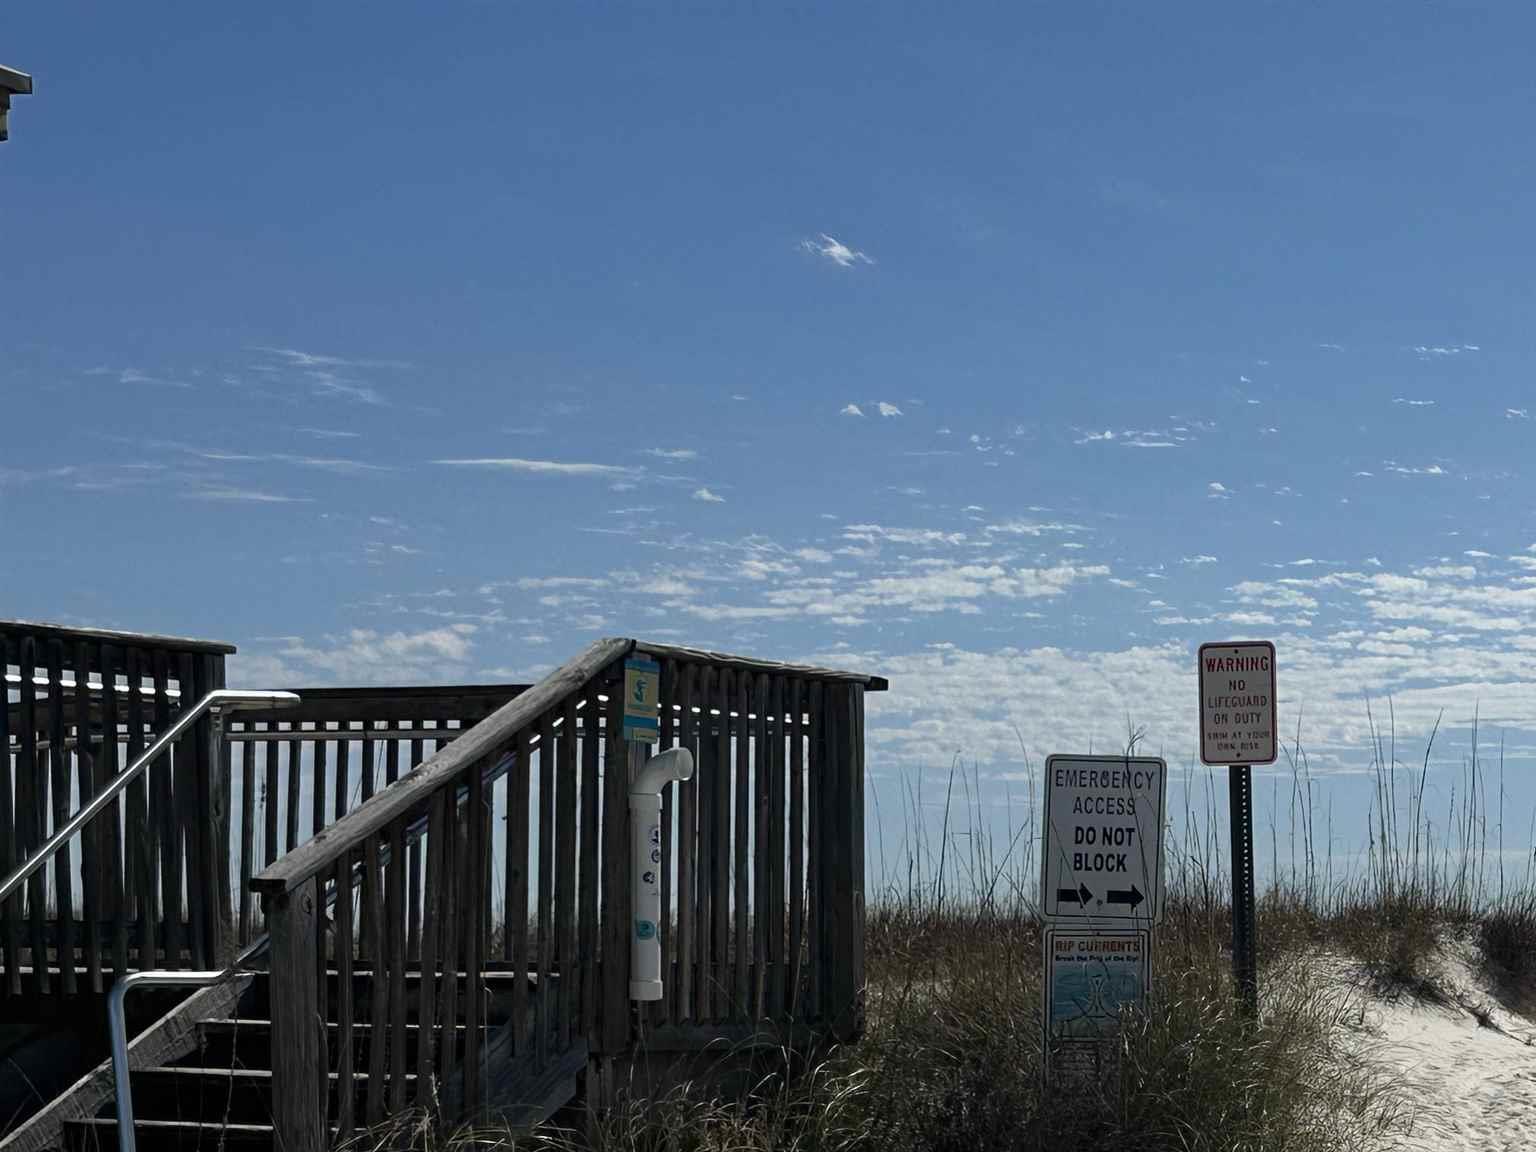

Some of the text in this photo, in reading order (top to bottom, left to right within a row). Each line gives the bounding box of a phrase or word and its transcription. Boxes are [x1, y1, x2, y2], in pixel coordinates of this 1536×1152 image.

[1205, 656, 1269, 672] WARNING
[1228, 680, 1246, 691] NO
[1208, 695, 1267, 708] LIFEGUARD
[1214, 712, 1261, 724] ON DUTY
[1055, 769, 1154, 790] EMERGENCY
[1073, 796, 1136, 816] ACCESS
[1074, 826, 1136, 847] DO NOT
[1073, 852, 1128, 873] BLOCK
